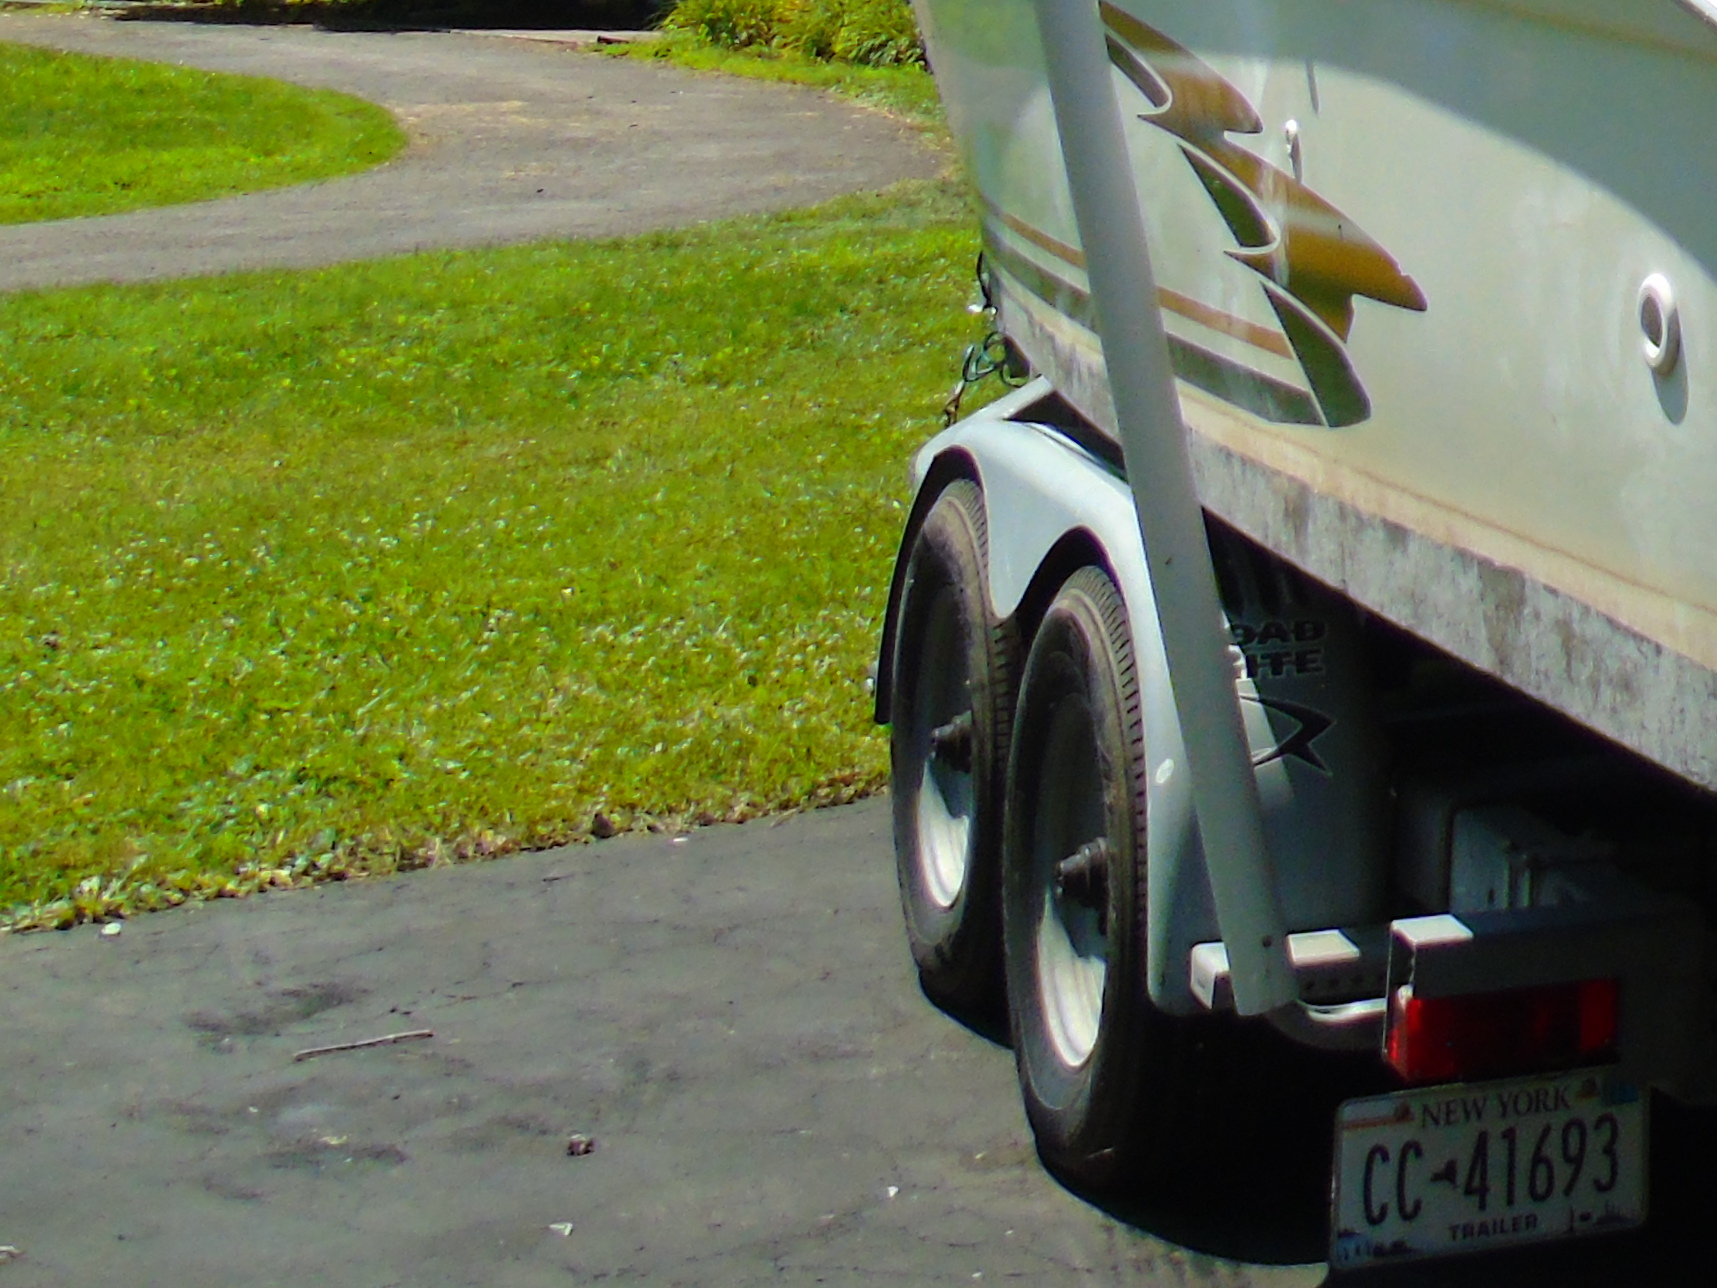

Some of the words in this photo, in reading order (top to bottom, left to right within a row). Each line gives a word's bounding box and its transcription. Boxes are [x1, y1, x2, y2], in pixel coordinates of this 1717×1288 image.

[1420, 1093, 1488, 1128] NEW
[1498, 1084, 1571, 1117] YORK
[1363, 1139, 1424, 1226] CC
[1463, 1112, 1620, 1212] 41693
[1450, 1213, 1539, 1243] TRAILER
